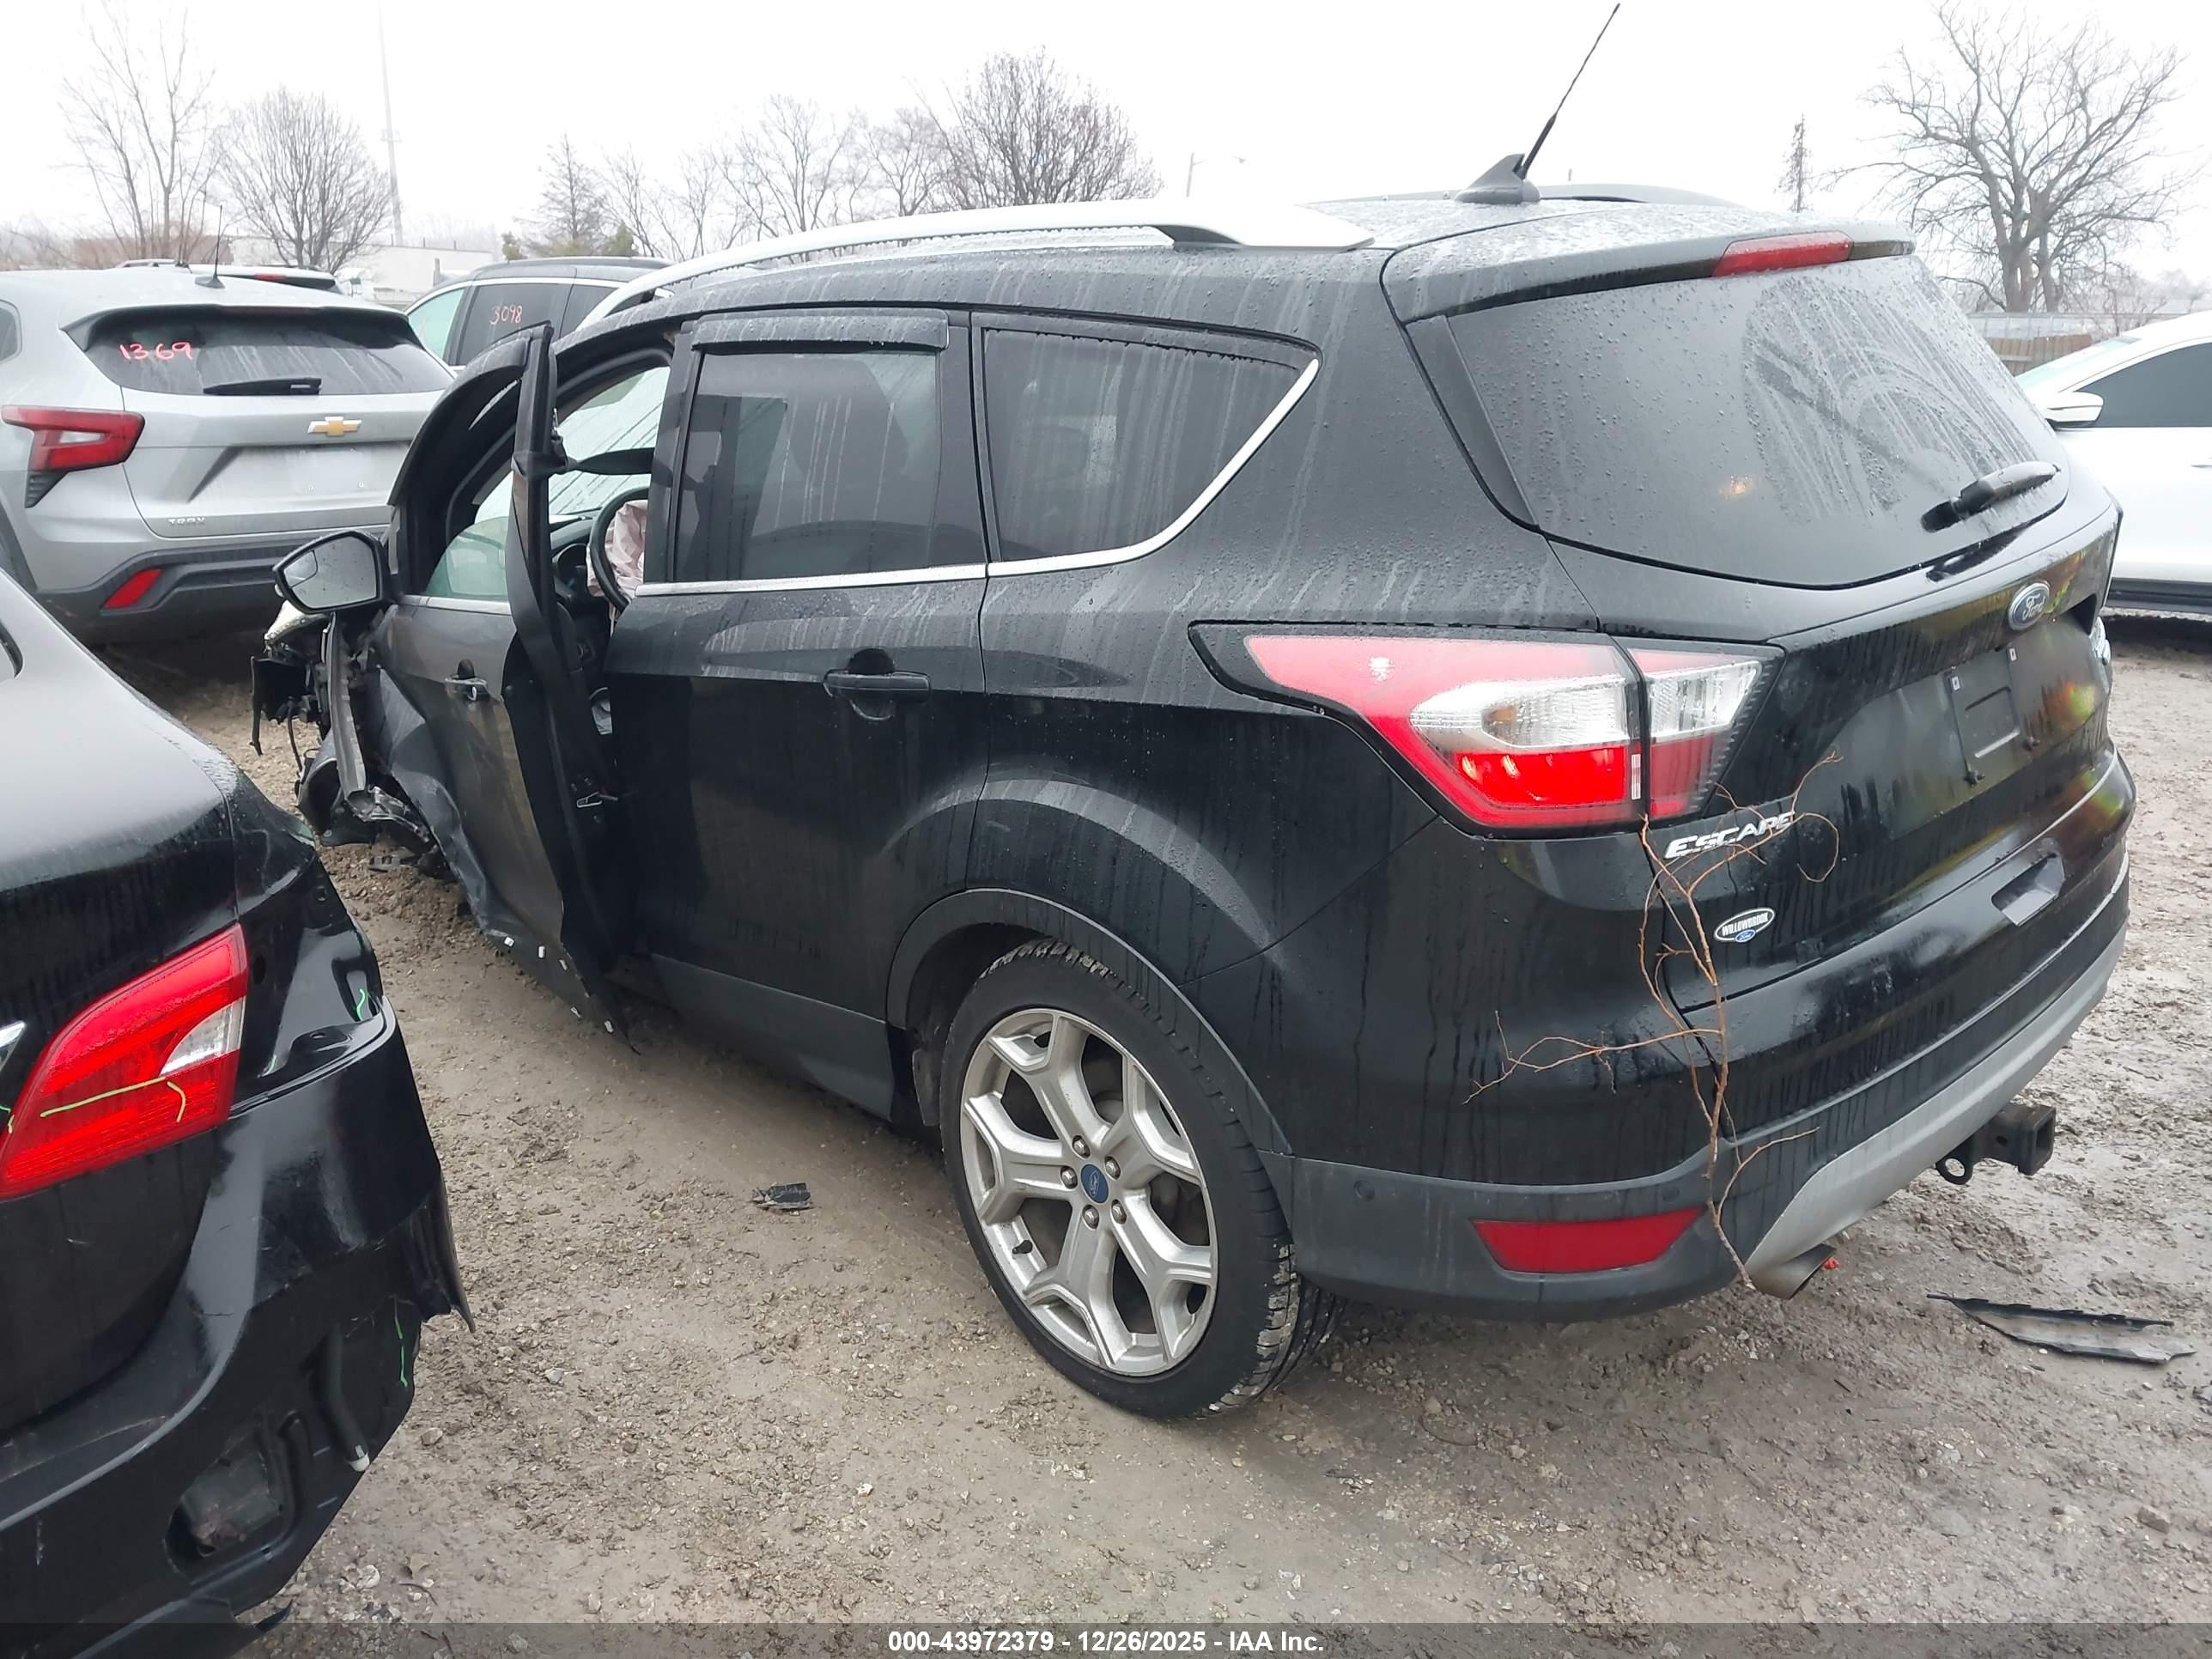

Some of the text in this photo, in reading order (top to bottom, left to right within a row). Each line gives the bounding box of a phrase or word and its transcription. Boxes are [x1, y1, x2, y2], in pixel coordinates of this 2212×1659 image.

[489, 304, 523, 325] 3098
[119, 342, 193, 360] 1369
[2021, 592, 2046, 621] Ford
[1664, 811, 1796, 860] ESCAPE
[1722, 912, 1769, 937] WILLOWBROOK
